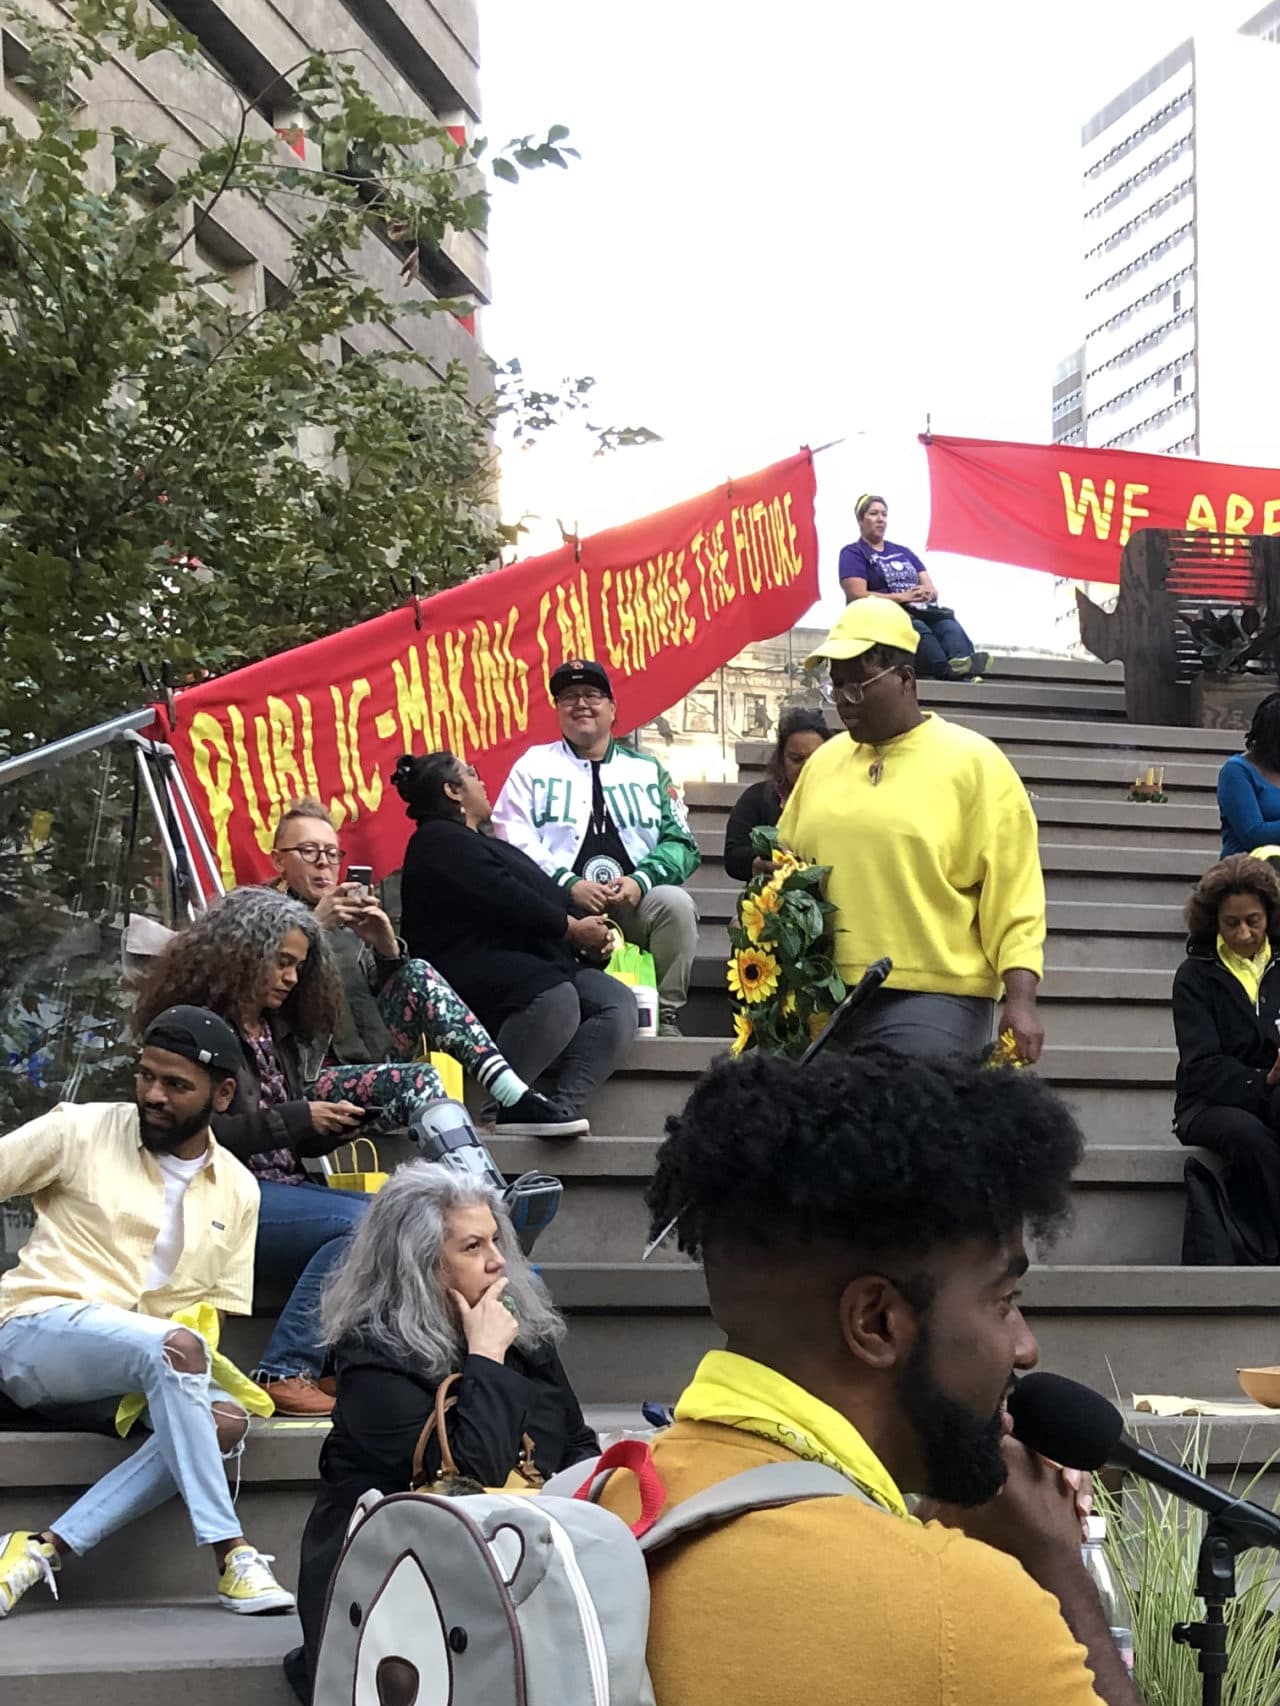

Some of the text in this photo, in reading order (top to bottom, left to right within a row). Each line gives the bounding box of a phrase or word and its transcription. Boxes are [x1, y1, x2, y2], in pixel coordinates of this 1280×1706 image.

[1058, 471, 1149, 546] WE
[536, 568, 596, 709] CAN
[600, 549, 697, 677] CHANGE
[691, 519, 735, 622] THE
[730, 491, 803, 595] FUTURE
